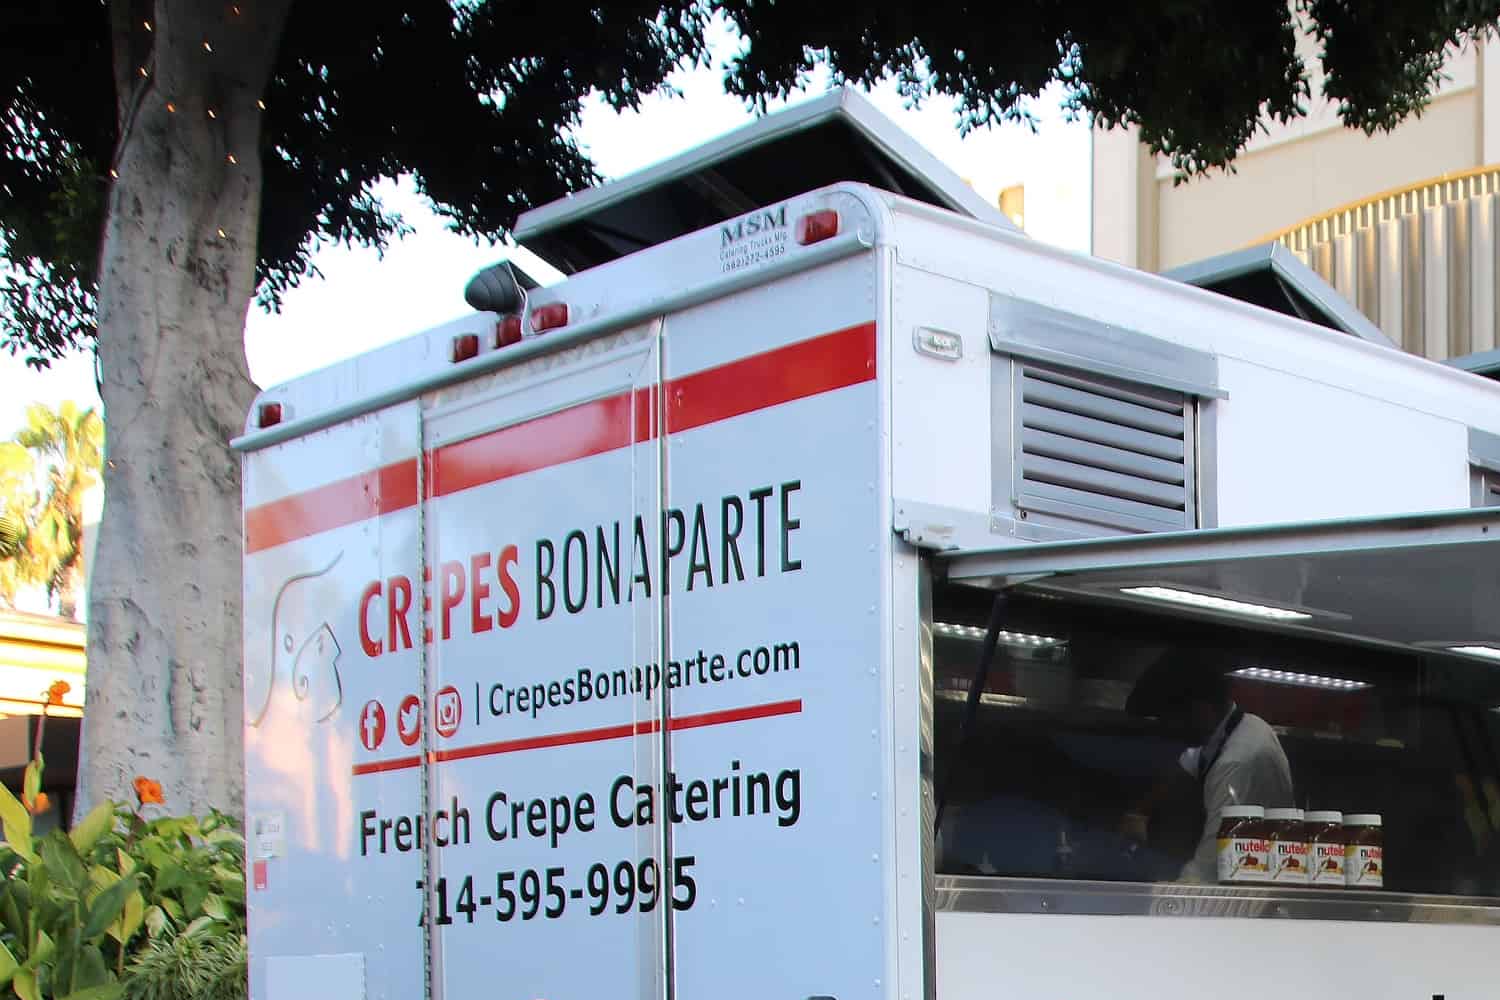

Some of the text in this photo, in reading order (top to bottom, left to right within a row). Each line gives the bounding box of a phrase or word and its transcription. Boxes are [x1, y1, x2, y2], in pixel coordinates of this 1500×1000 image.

[720, 205, 787, 247] MSM
[535, 480, 802, 620] BONAPARTE
[488, 638, 800, 717] CrepesBonaparte.com
[486, 790, 595, 849] Crepe
[609, 761, 801, 828] Catering
